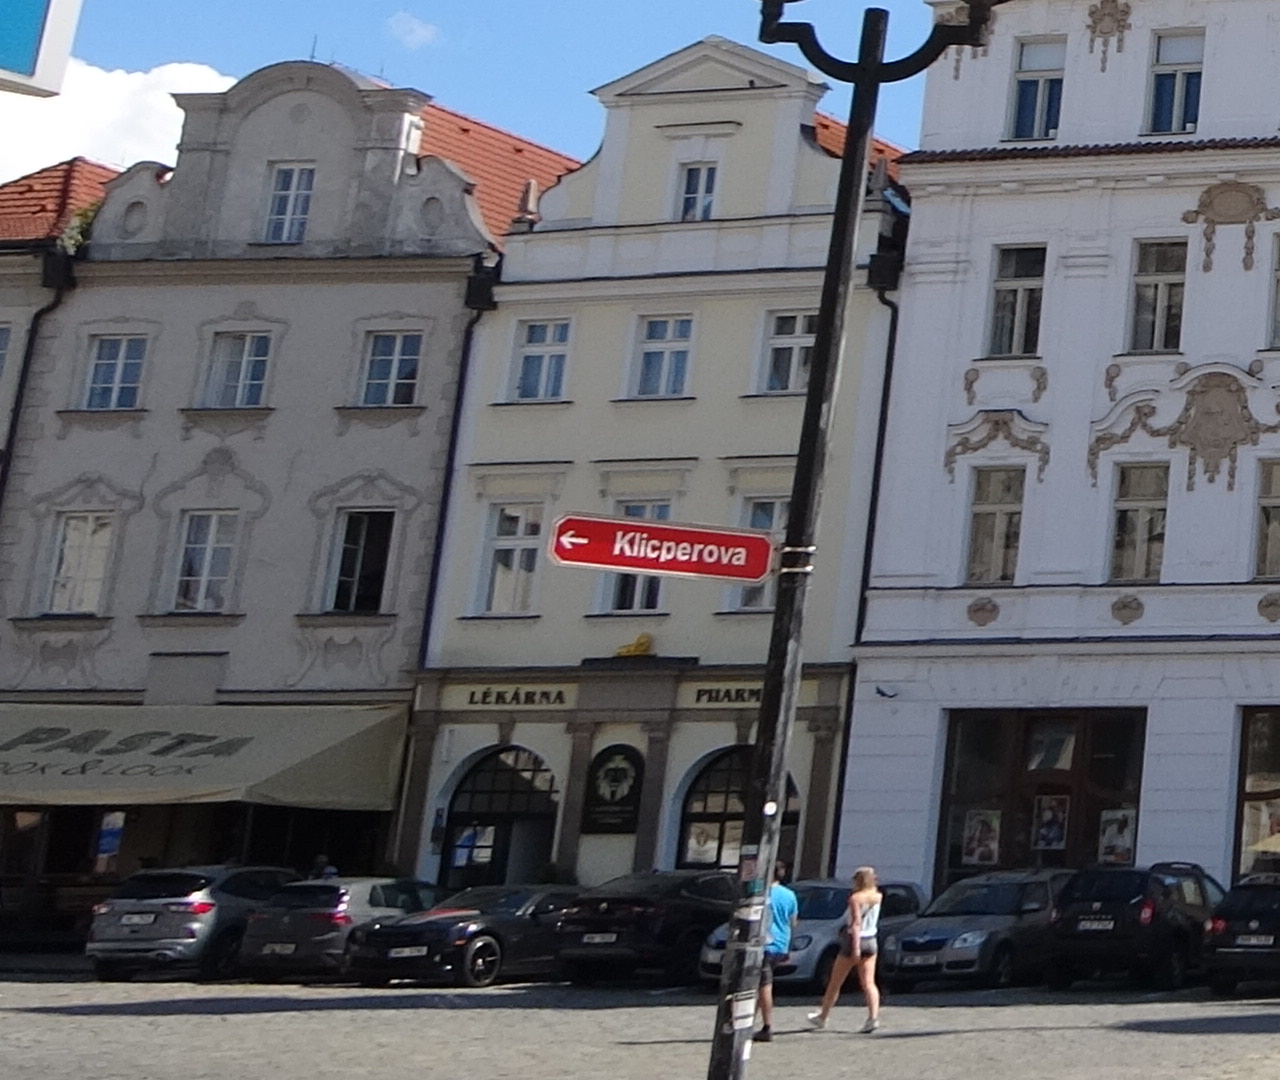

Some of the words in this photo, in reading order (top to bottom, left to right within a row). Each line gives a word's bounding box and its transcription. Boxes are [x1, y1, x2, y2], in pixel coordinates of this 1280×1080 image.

[612, 530, 748, 566] Klicperova
[468, 687, 567, 705] LÉKÁRNA
[696, 688, 762, 703] PHARM
[0, 727, 255, 758] PASTA
